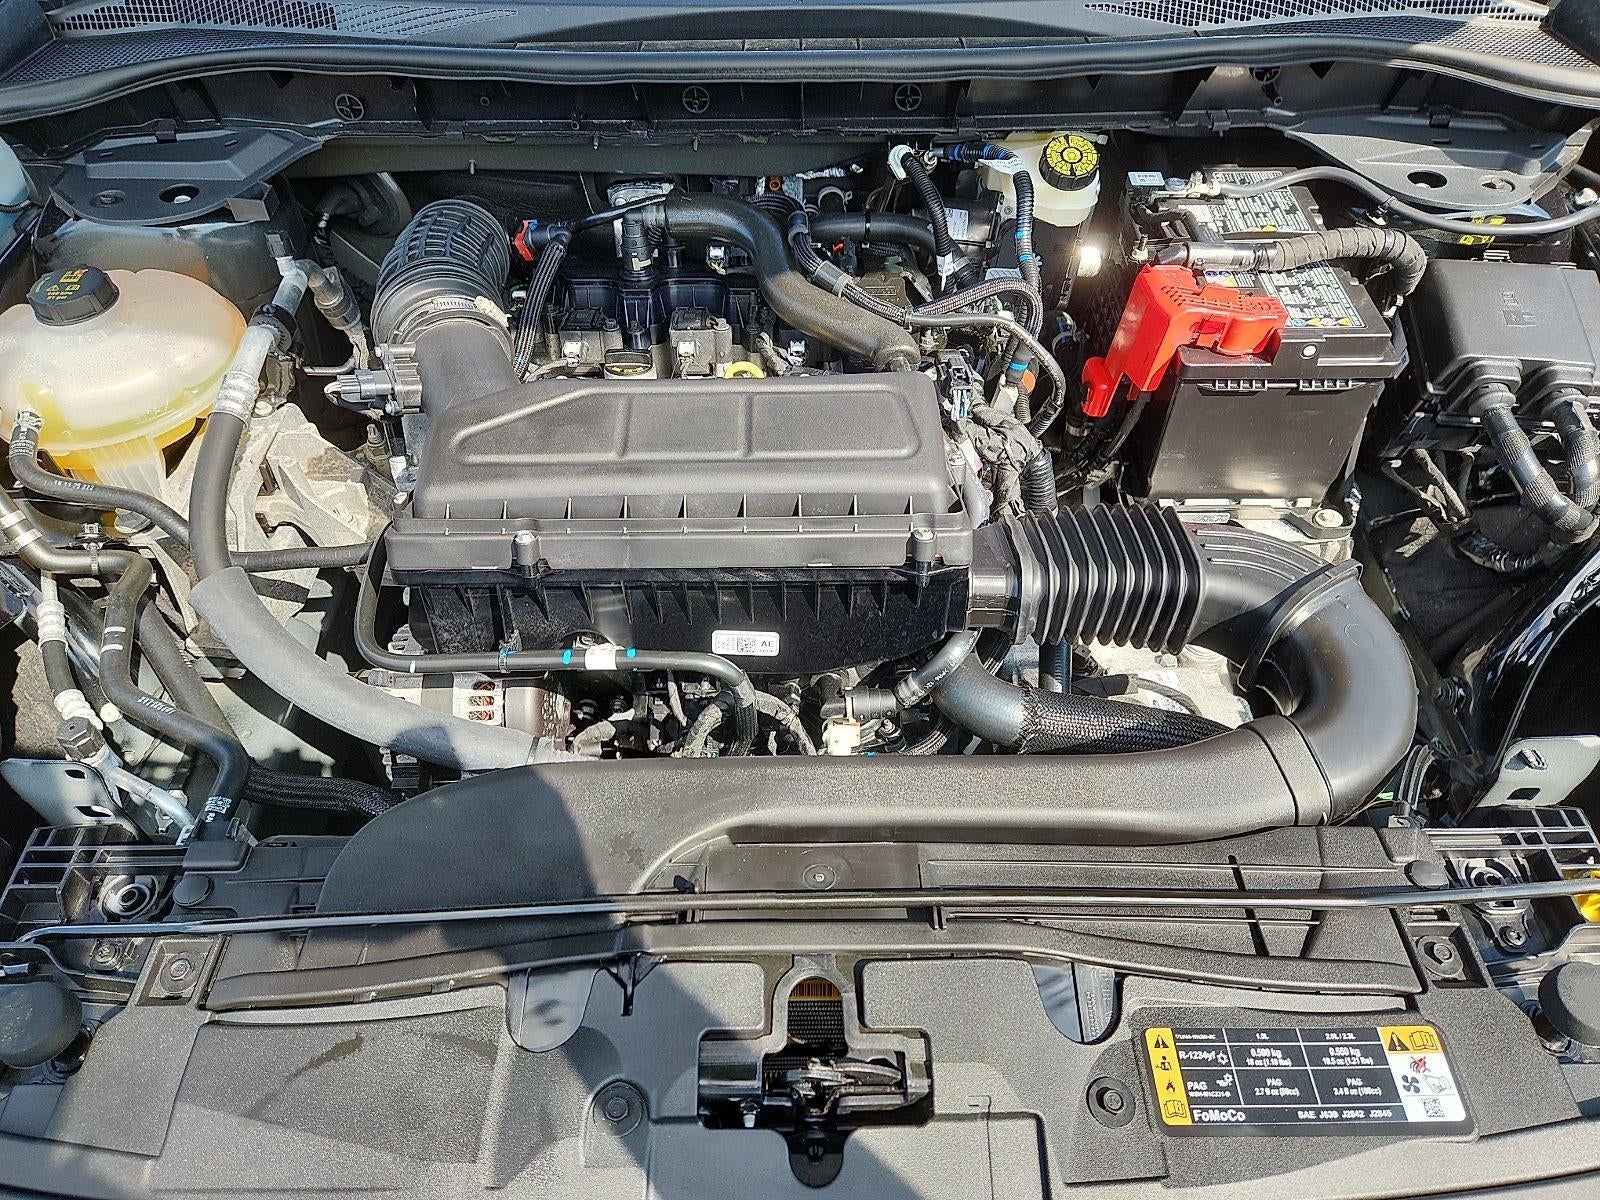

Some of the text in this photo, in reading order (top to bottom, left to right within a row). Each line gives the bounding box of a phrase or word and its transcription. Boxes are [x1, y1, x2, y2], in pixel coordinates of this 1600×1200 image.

[760, 640, 774, 648] AE
[1271, 1047, 1282, 1059] kg
[1349, 1046, 1361, 1058] kg
[1187, 1081, 1208, 1091] PAG
[1192, 1108, 1246, 1122] FoMoCo
